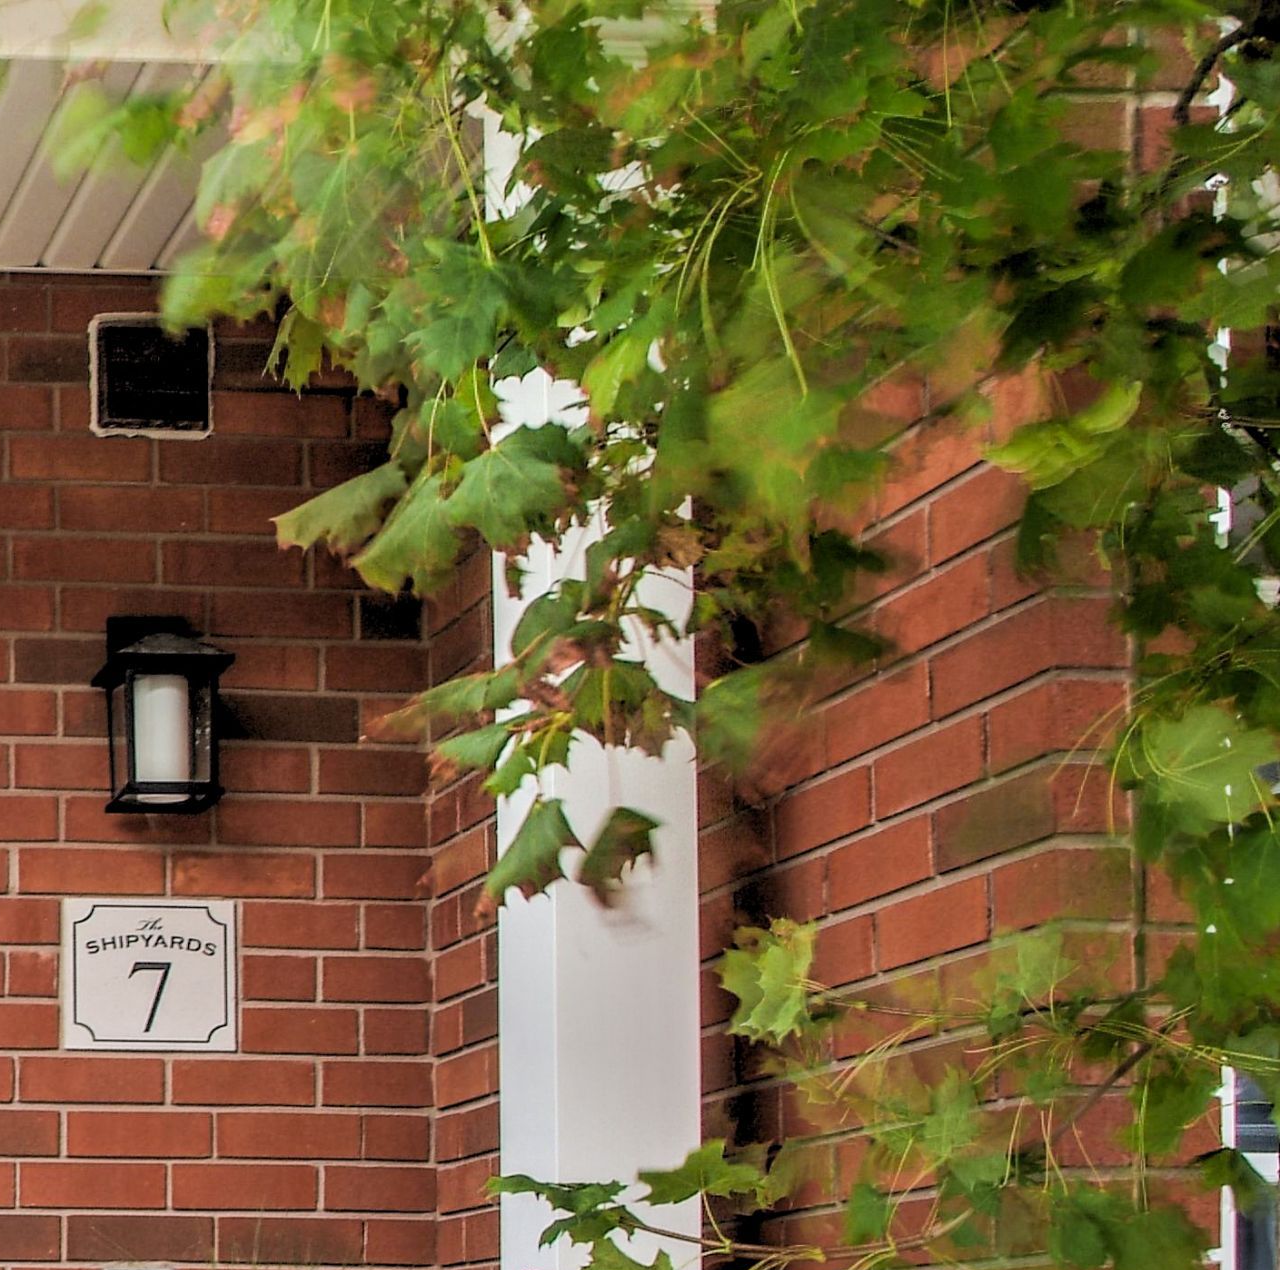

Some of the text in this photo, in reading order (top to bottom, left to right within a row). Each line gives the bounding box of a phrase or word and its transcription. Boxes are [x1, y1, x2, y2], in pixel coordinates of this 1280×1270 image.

[136, 917, 163, 930] The
[85, 934, 217, 956] SHIPYARDS
[128, 962, 172, 1033] 7
